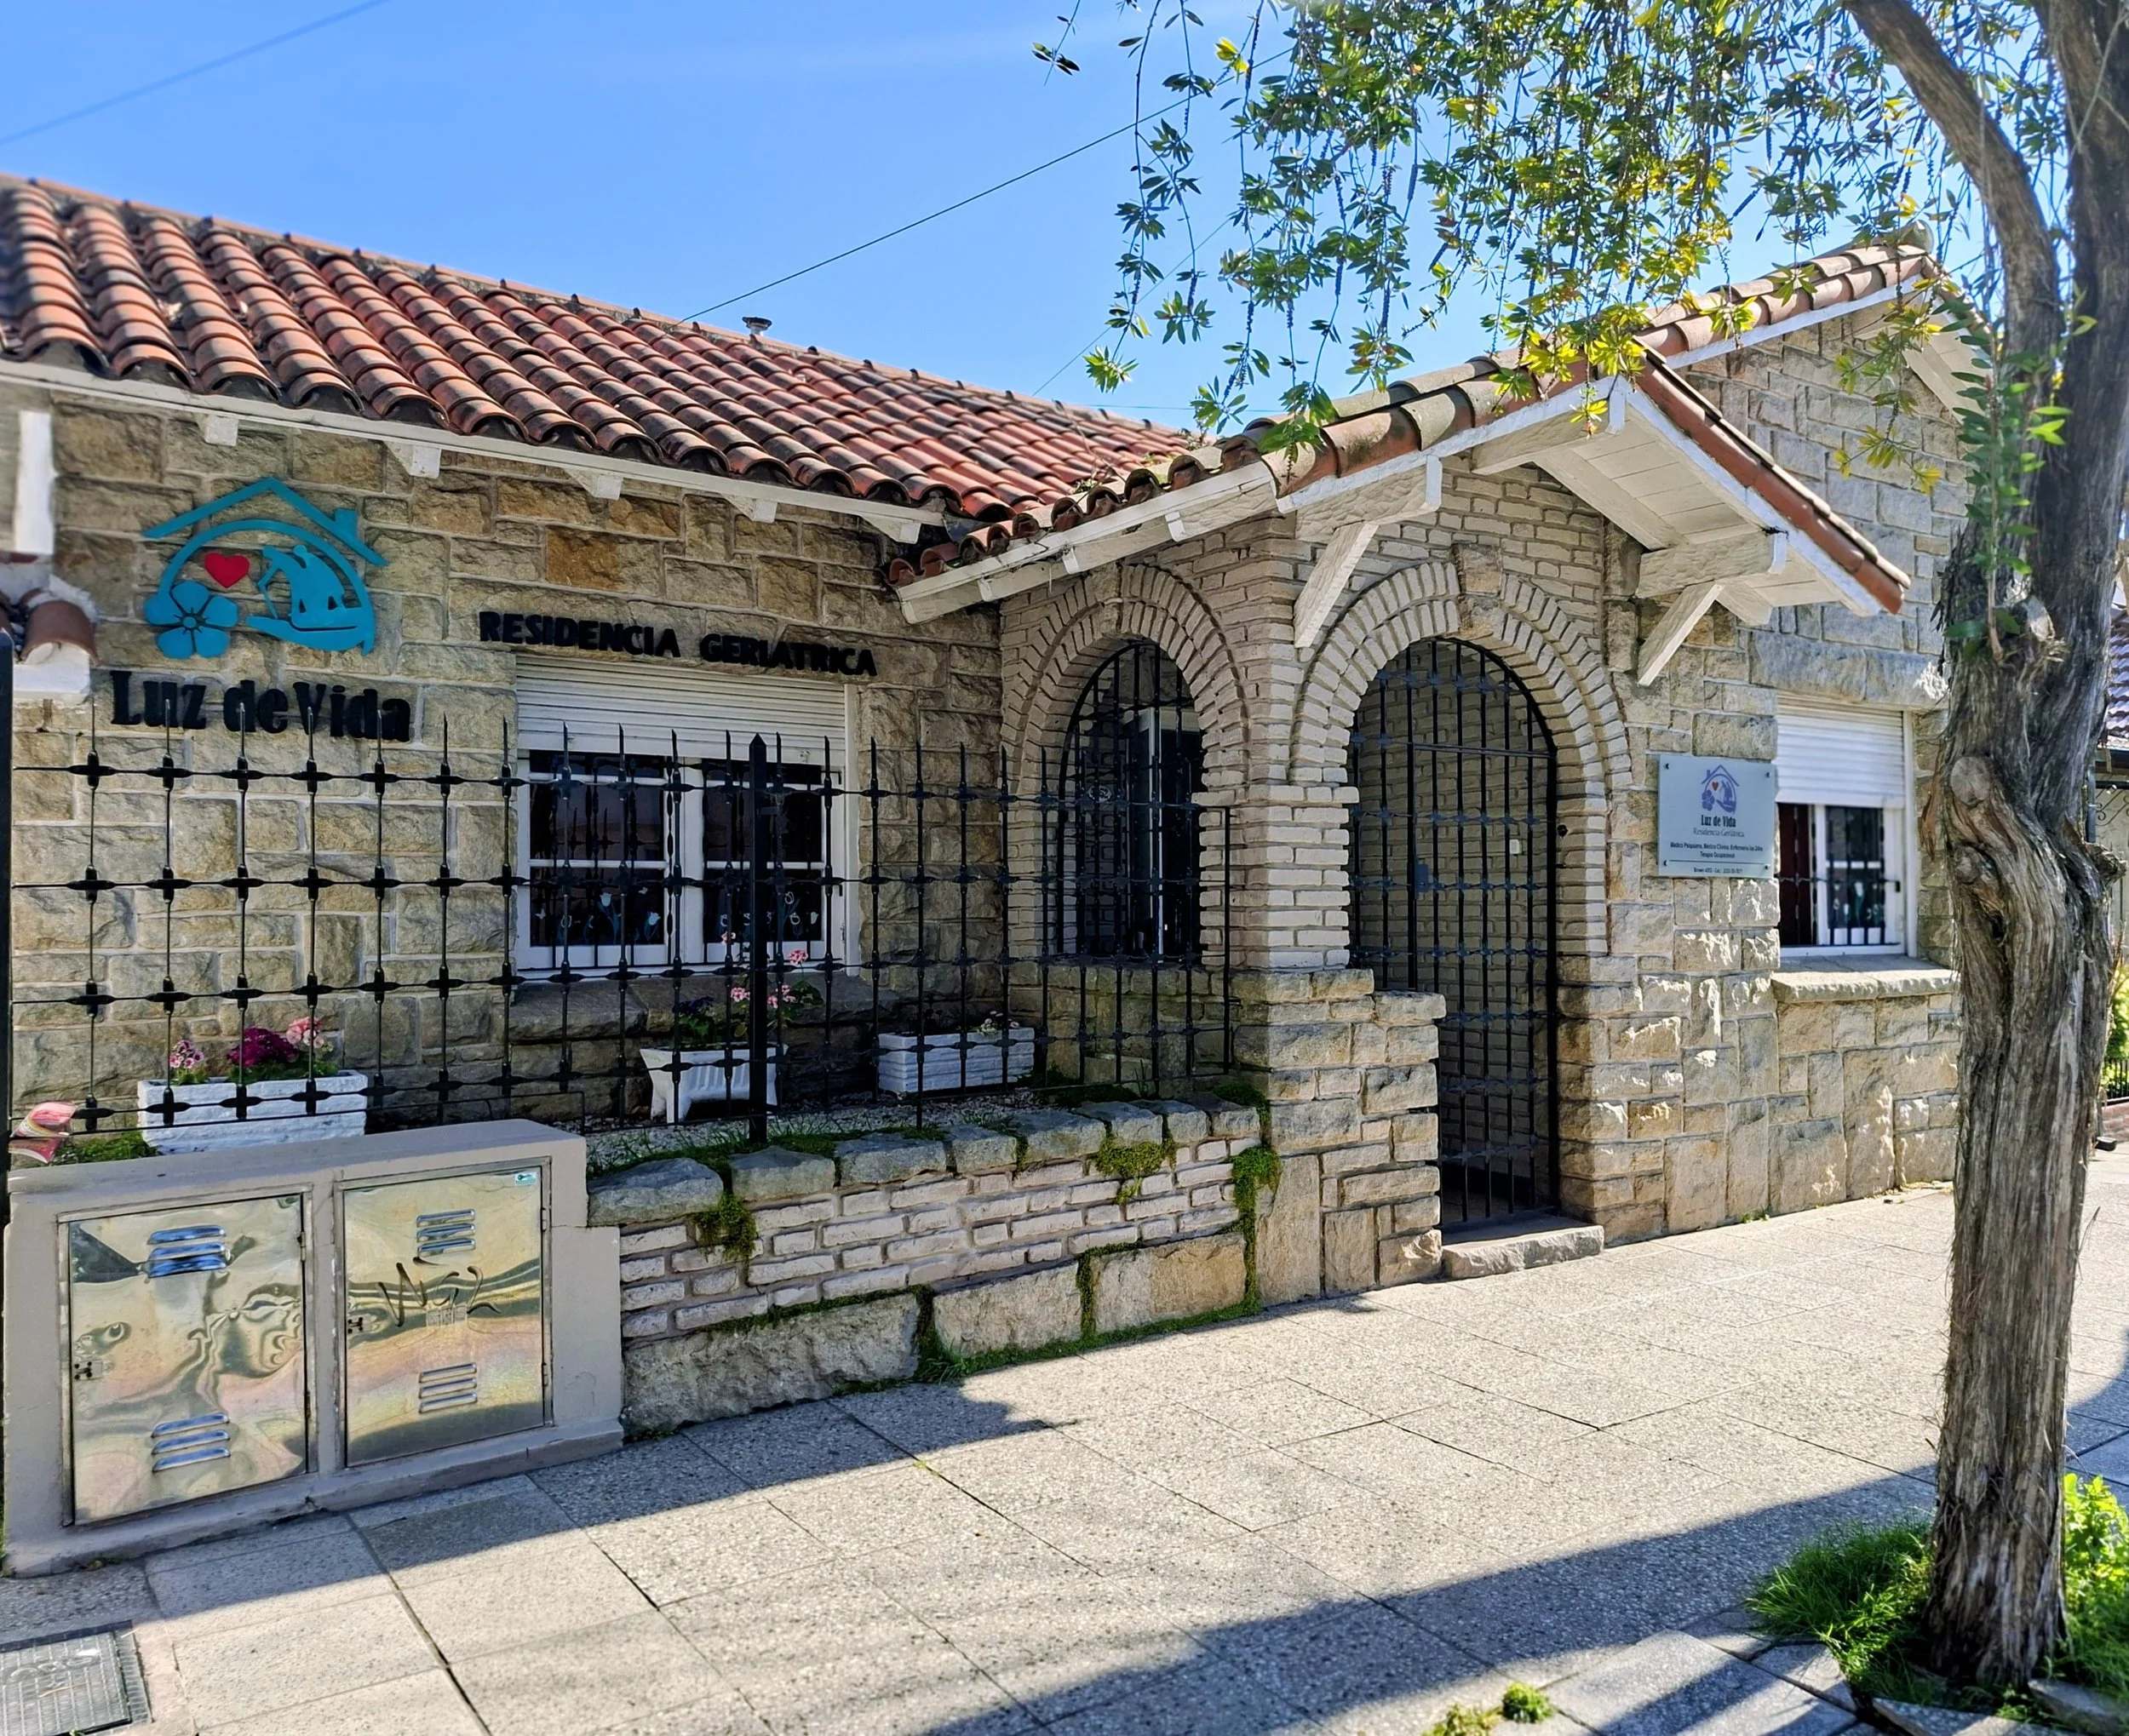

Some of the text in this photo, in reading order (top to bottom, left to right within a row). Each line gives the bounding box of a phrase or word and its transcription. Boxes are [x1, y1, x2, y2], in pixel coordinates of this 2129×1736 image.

[479, 610, 879, 677] RESIDENCIA GERIATRICA
[110, 669, 410, 742] Luz de Vida
[1701, 815, 1736, 827] Luz de Vida
